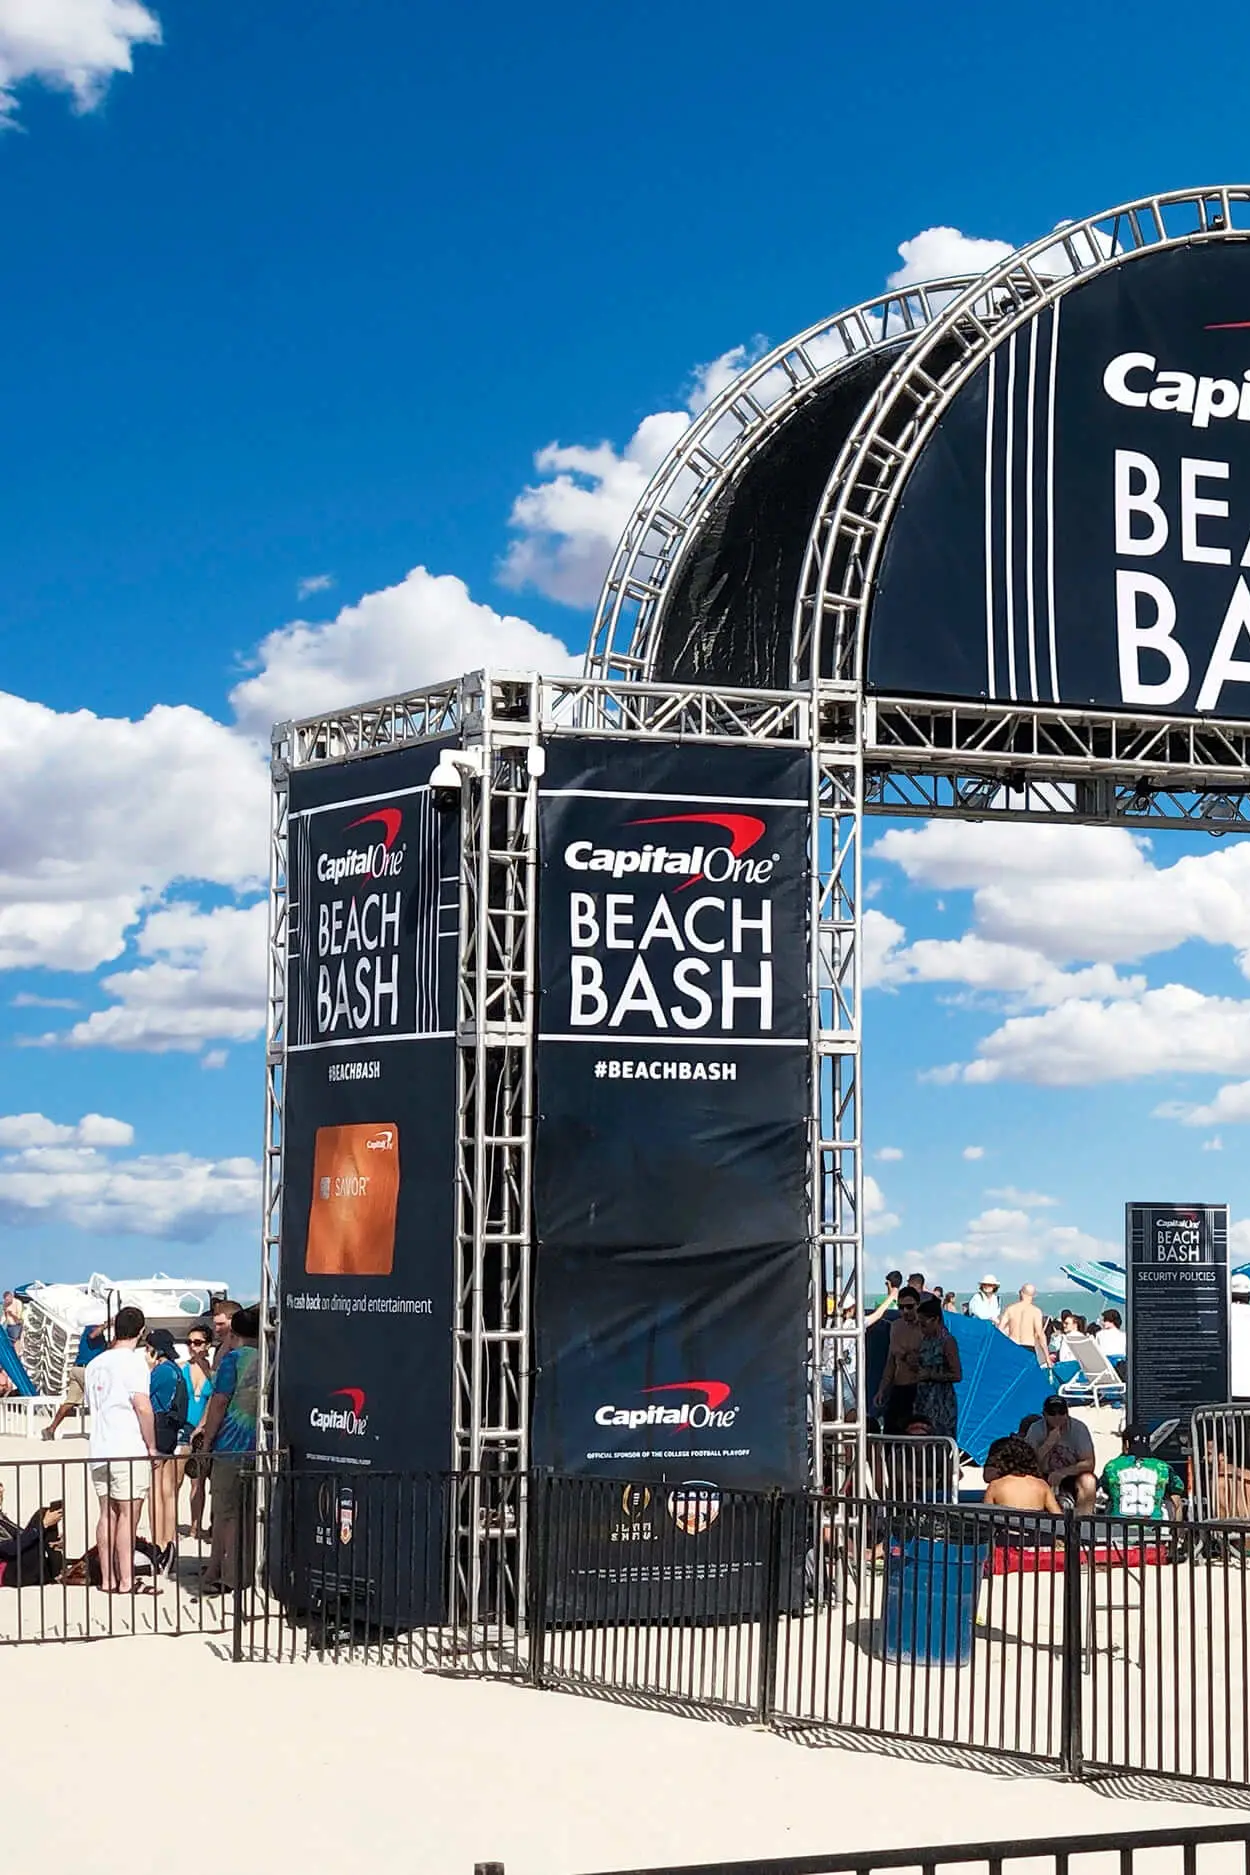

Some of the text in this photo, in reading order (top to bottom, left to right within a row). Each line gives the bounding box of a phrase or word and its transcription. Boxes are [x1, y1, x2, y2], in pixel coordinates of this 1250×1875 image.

[318, 891, 401, 957] BEACH
[569, 892, 772, 954] BEACH
[317, 953, 399, 1033] BASH
[569, 952, 773, 1031] BASH
[328, 1060, 381, 1082] #BEACHBASH
[593, 1060, 737, 1081] #BEACHBASH
[1157, 1230, 1200, 1244] BEACH
[1157, 1244, 1200, 1262] BASH
[1138, 1271, 1216, 1281] SECURITY POLICIES
[330, 1293, 351, 1316] dining
[352, 1294, 367, 1312] and
[367, 1296, 433, 1314] entertainment
[641, 1450, 650, 1458] OF
[651, 1450, 663, 1458] THE
[690, 1449, 721, 1458] FOOTBALL
[1119, 1483, 1156, 1516] 25
